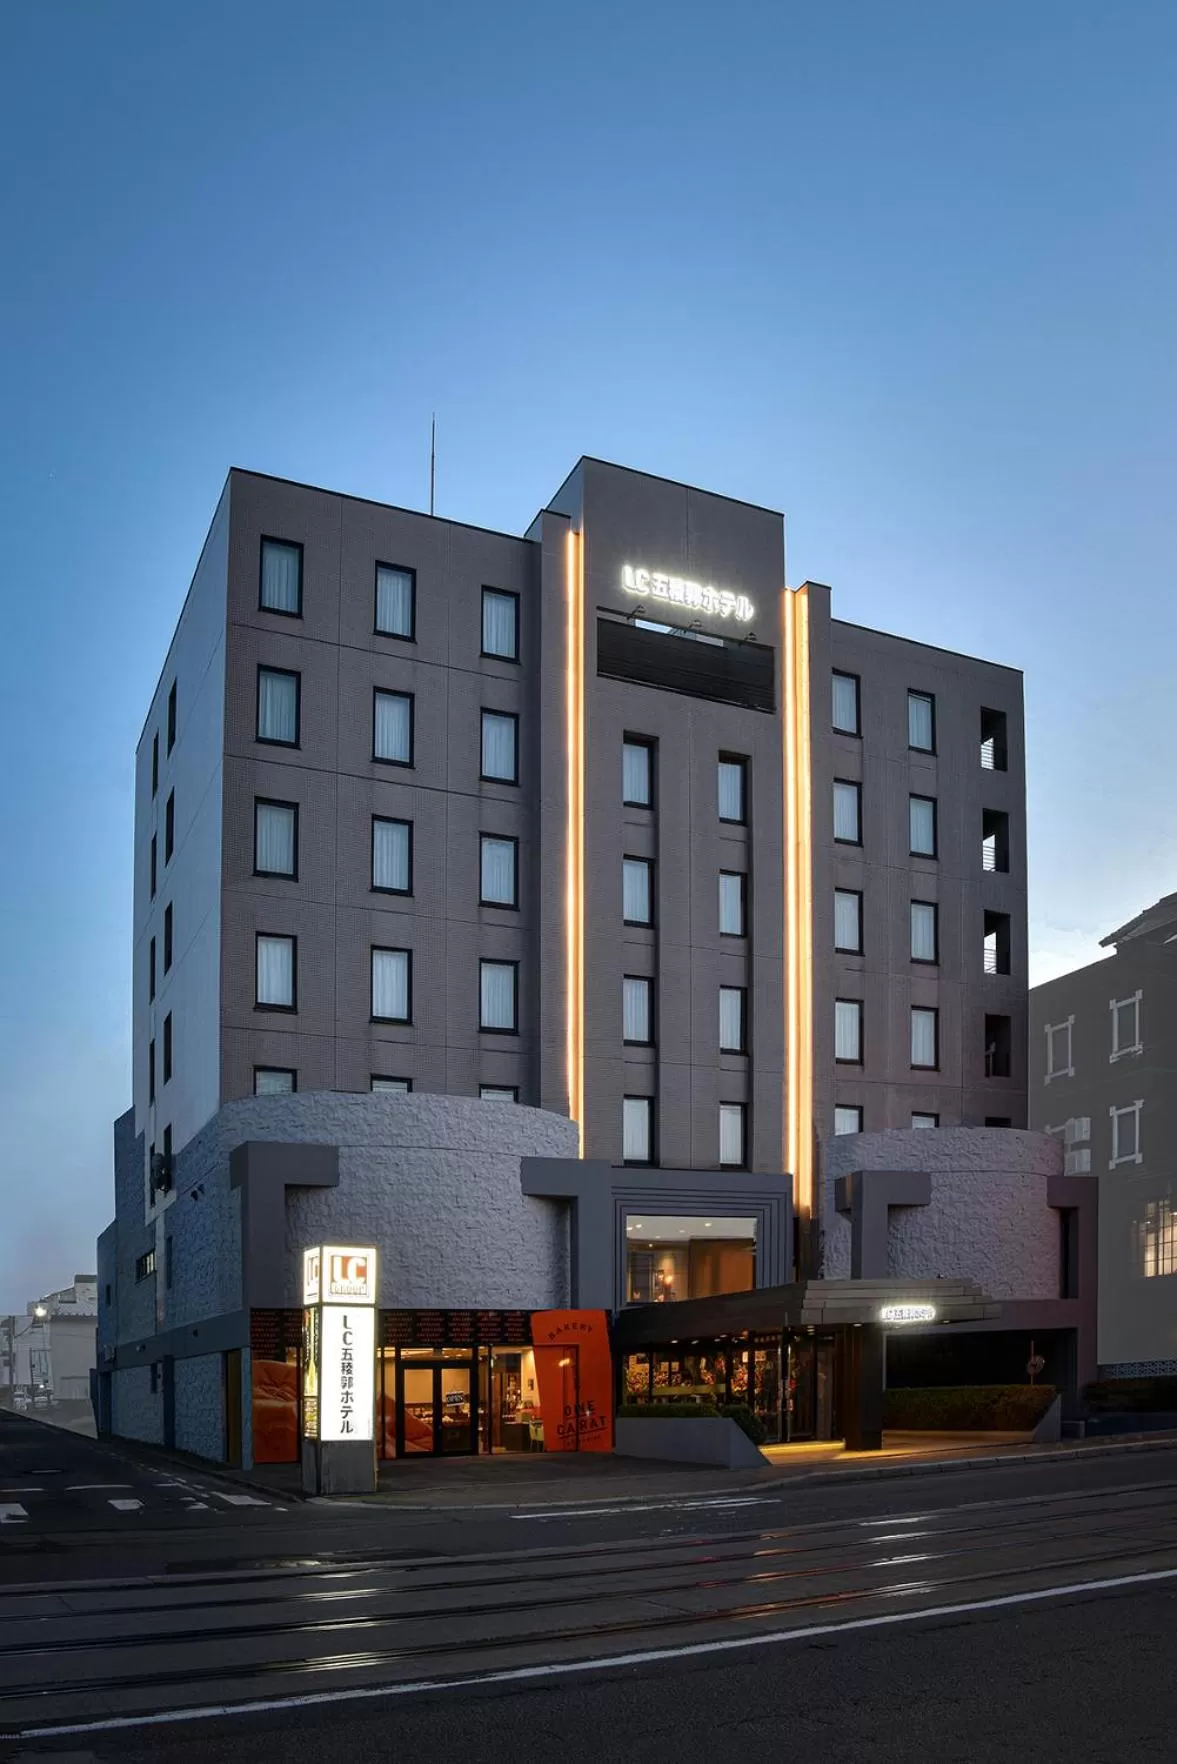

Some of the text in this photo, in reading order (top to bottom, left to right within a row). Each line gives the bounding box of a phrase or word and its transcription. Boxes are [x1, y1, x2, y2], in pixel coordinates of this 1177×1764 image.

[333, 1256, 367, 1284] LC
[340, 1315, 354, 1434] LC五稜郭ホテル
